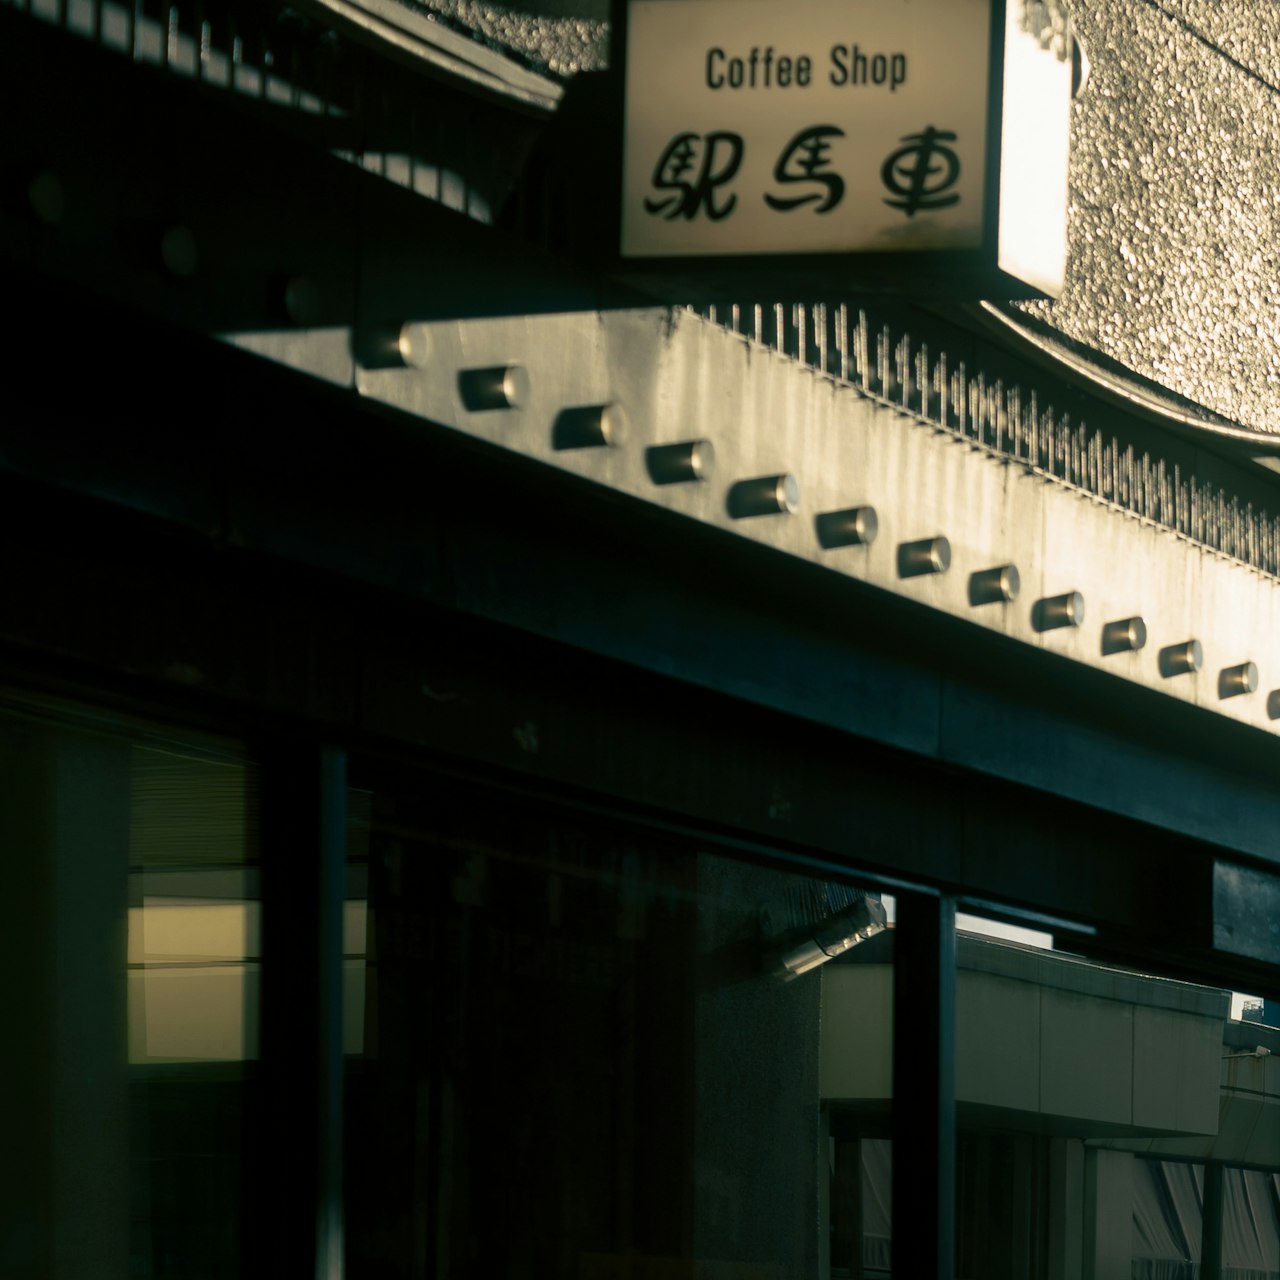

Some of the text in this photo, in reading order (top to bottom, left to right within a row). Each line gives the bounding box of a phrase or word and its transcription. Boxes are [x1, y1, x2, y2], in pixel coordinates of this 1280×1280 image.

[706, 45, 907, 93] Coffee Shop
[644, 125, 961, 221] 駅馬車
